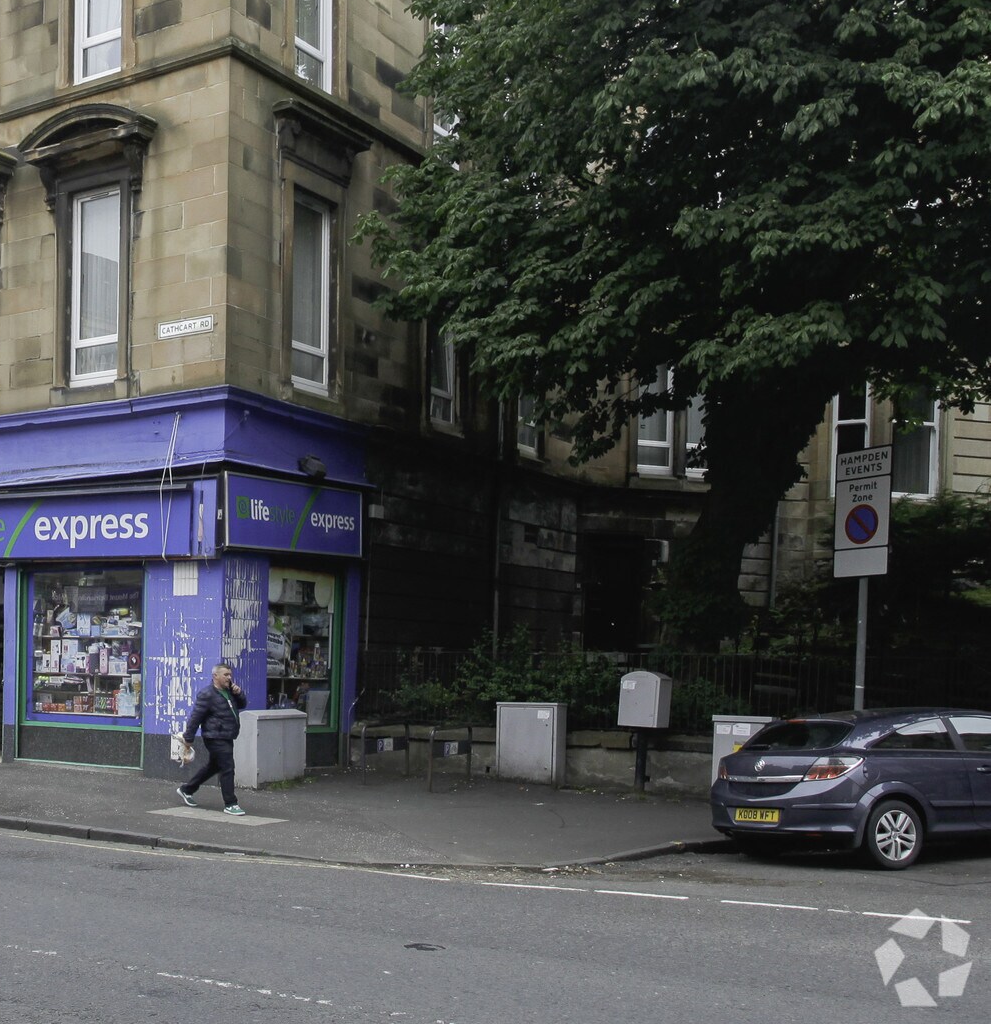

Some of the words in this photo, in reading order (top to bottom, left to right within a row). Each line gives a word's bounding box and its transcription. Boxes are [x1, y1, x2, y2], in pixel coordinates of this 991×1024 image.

[161, 322, 197, 335] CATHCART
[199, 320, 211, 328] RD
[840, 451, 889, 466] HAMPDEN
[845, 462, 883, 476] EVENTS
[849, 481, 878, 493] Permit
[852, 494, 873, 503] Zone
[250, 498, 296, 529] lifestyle
[310, 511, 355, 534] express
[34, 512, 149, 549] express
[758, 810, 776, 821] WFT
